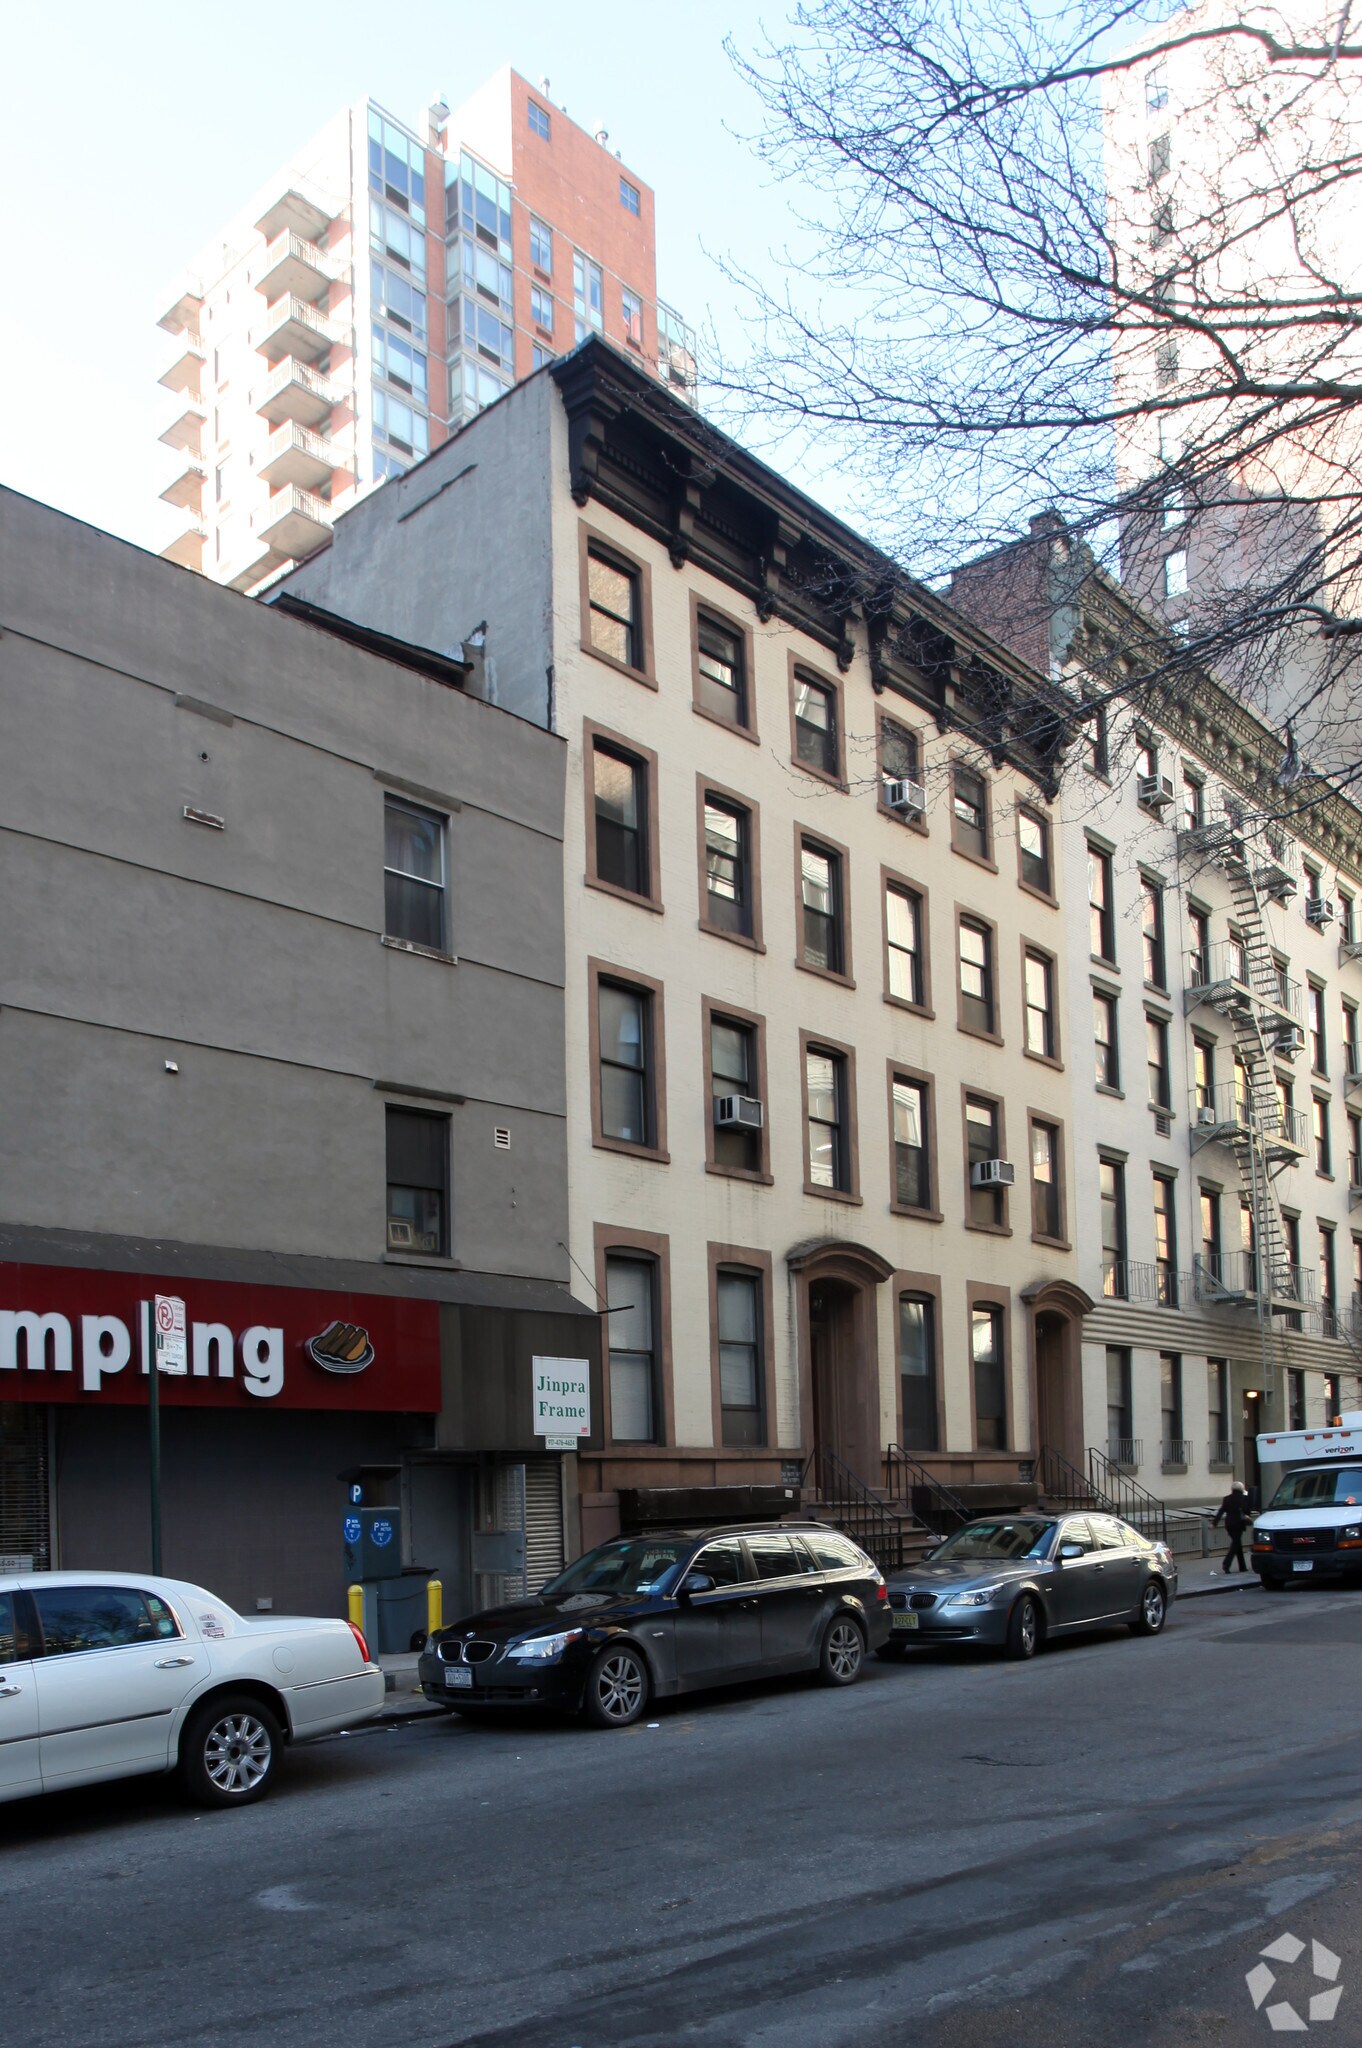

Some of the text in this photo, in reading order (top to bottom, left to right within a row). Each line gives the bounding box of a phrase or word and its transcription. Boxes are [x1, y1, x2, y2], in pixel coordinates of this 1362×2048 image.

[537, 1375, 586, 1396] Jinpra
[539, 1401, 586, 1418] Frame
[1325, 1446, 1355, 1454] verizon
[353, 1485, 361, 1502] P
[374, 1522, 379, 1531] P
